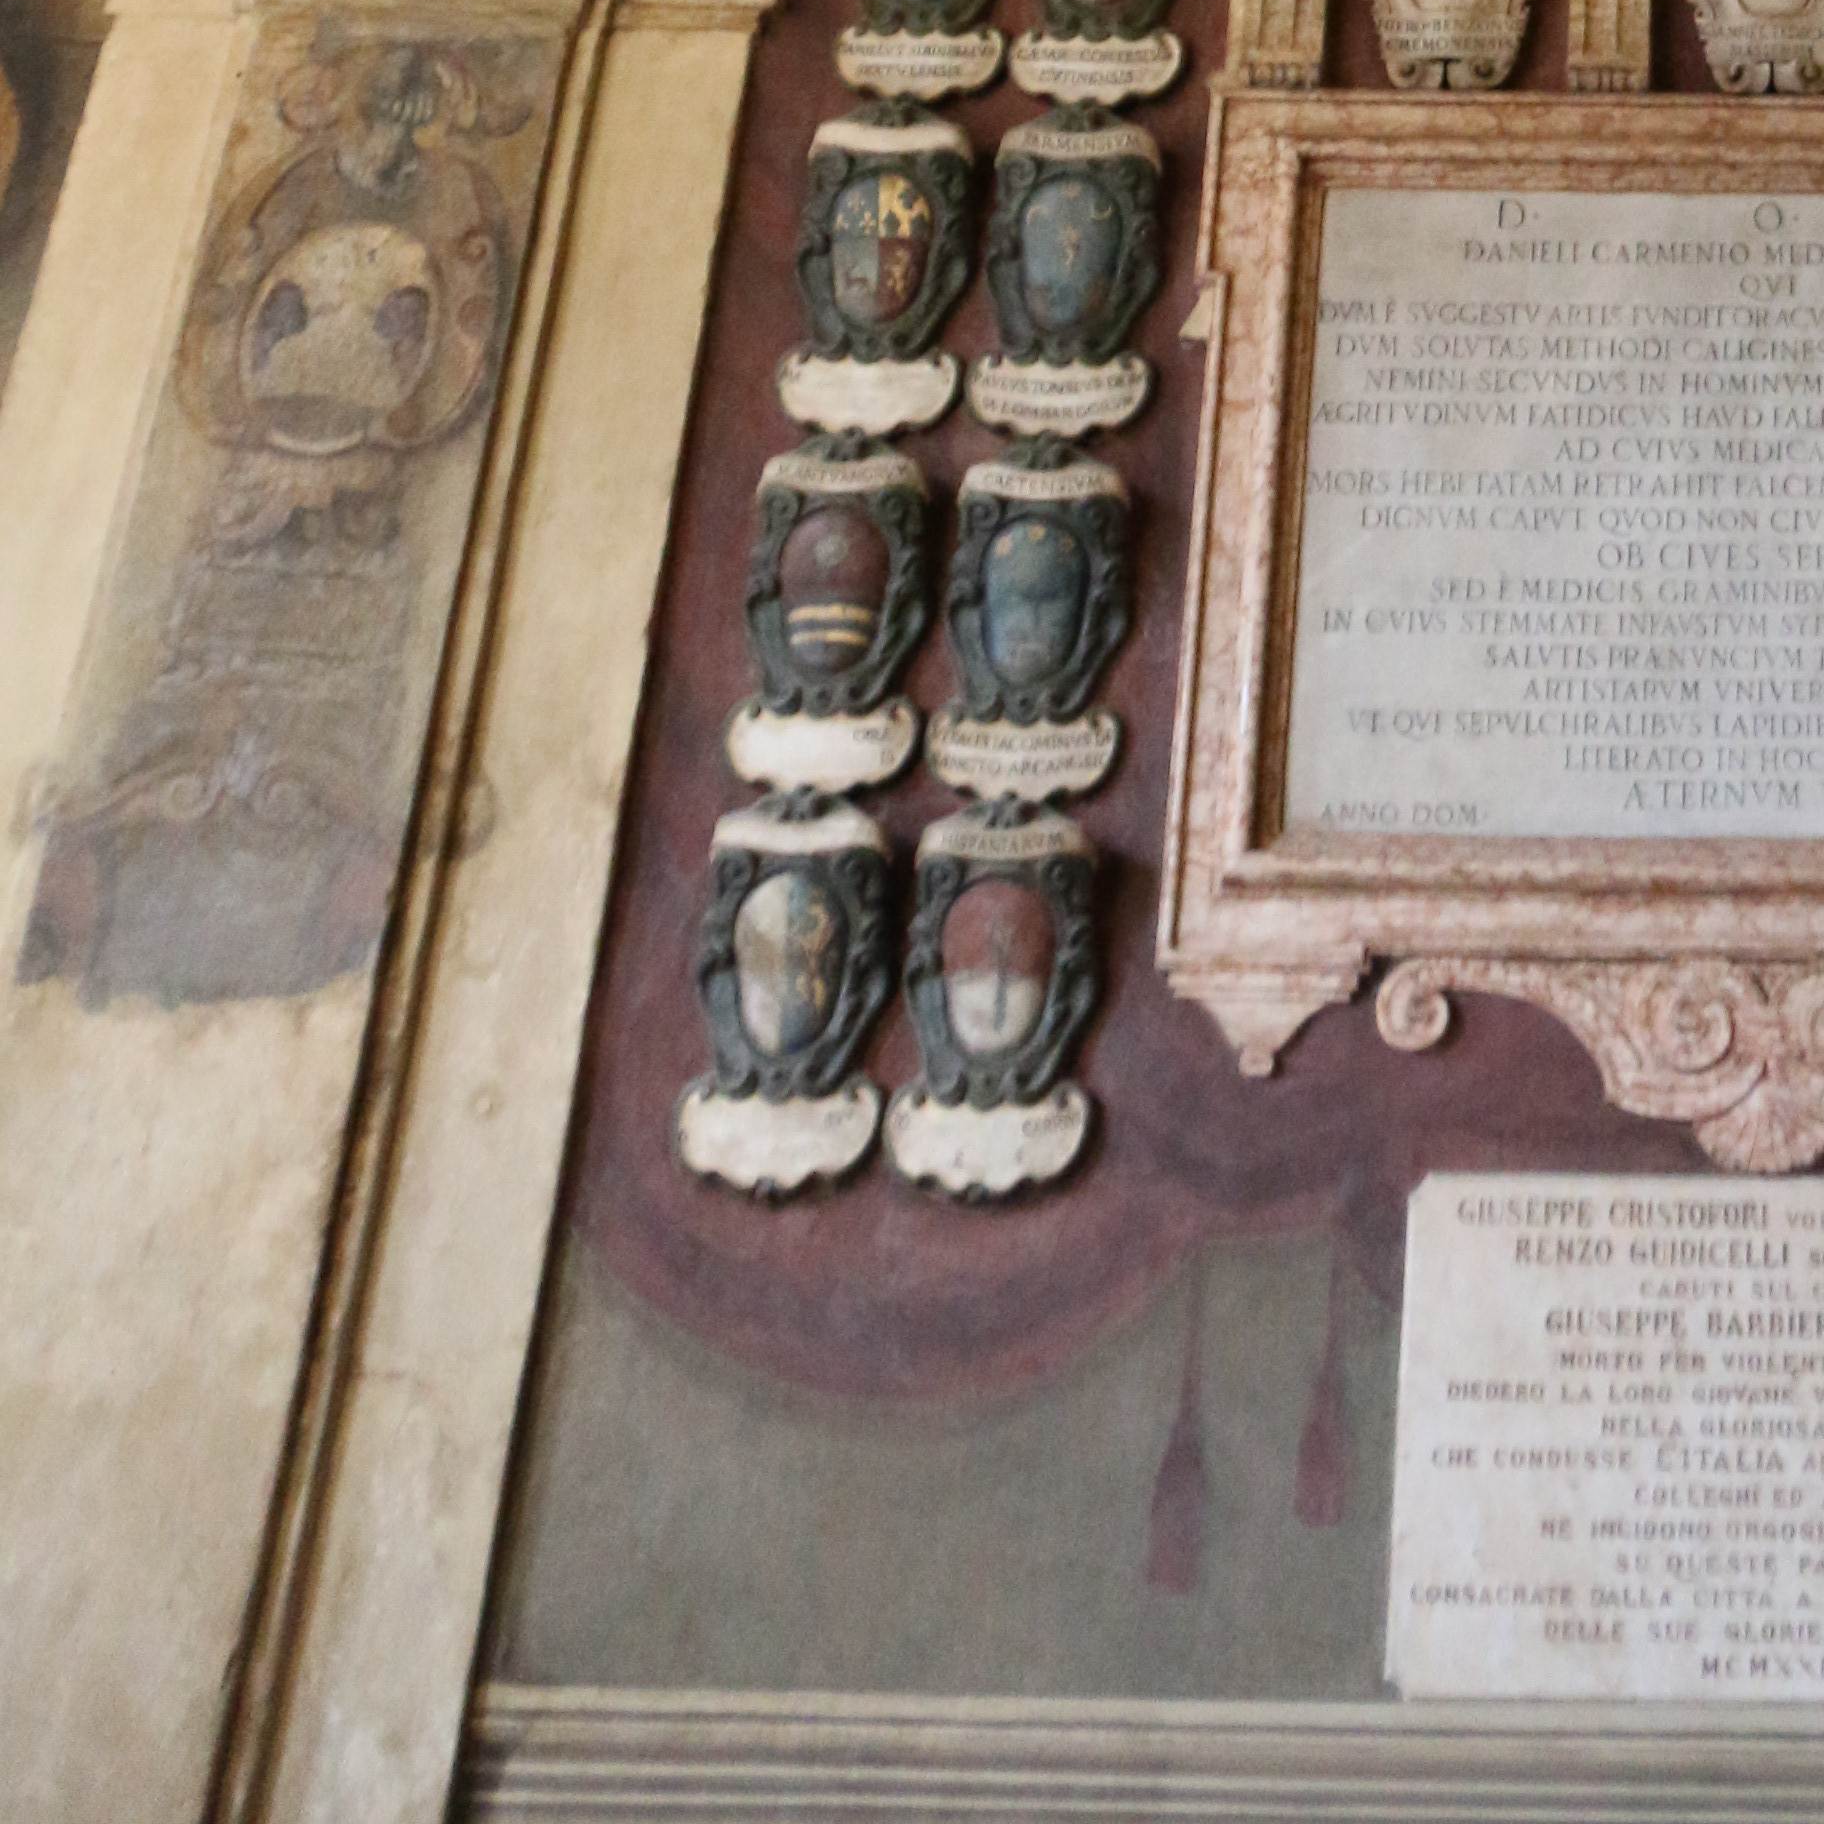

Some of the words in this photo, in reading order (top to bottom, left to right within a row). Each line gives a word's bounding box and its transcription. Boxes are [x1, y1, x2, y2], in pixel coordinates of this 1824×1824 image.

[1463, 240, 1581, 264] DANIELI
[1591, 240, 1751, 265] CARMENIO
[1739, 273, 1796, 301] QVI
[1334, 335, 1398, 358] DVM
[1412, 335, 1529, 360] SOLVTAS
[1539, 336, 1671, 361] METHODI
[1478, 369, 1627, 394] SECVNDVS
[1638, 370, 1665, 394] IN
[1679, 371, 1822, 396] HOMINVM
[1682, 404, 1763, 429] HAVD
[1553, 439, 1601, 463] AD
[1612, 439, 1700, 463] CVIVS
[1712, 440, 1823, 464] MEDICA
[1360, 504, 1479, 530] DIGNVM
[1597, 507, 1686, 536] QVOD
[1697, 508, 1758, 533] NON
[1596, 541, 1645, 570] OB
[1659, 541, 1763, 572] CIVES
[1430, 578, 1487, 603] SED
[1519, 578, 1644, 604] MEDICIS
[1484, 643, 1599, 669] SALVTIS
[1392, 711, 1442, 743] QVI
[1718, 747, 1745, 772] IN
[1760, 747, 1816, 773] HOC
[1320, 802, 1399, 825] ANNO
[1456, 1197, 1594, 1229] GIUSEPPE
[1607, 1197, 1769, 1230] CRISTOFORI
[1515, 1236, 1614, 1266] RENZO
[1544, 1305, 1684, 1337] GIUSEPPE
[1560, 1383, 1592, 1404] LA
